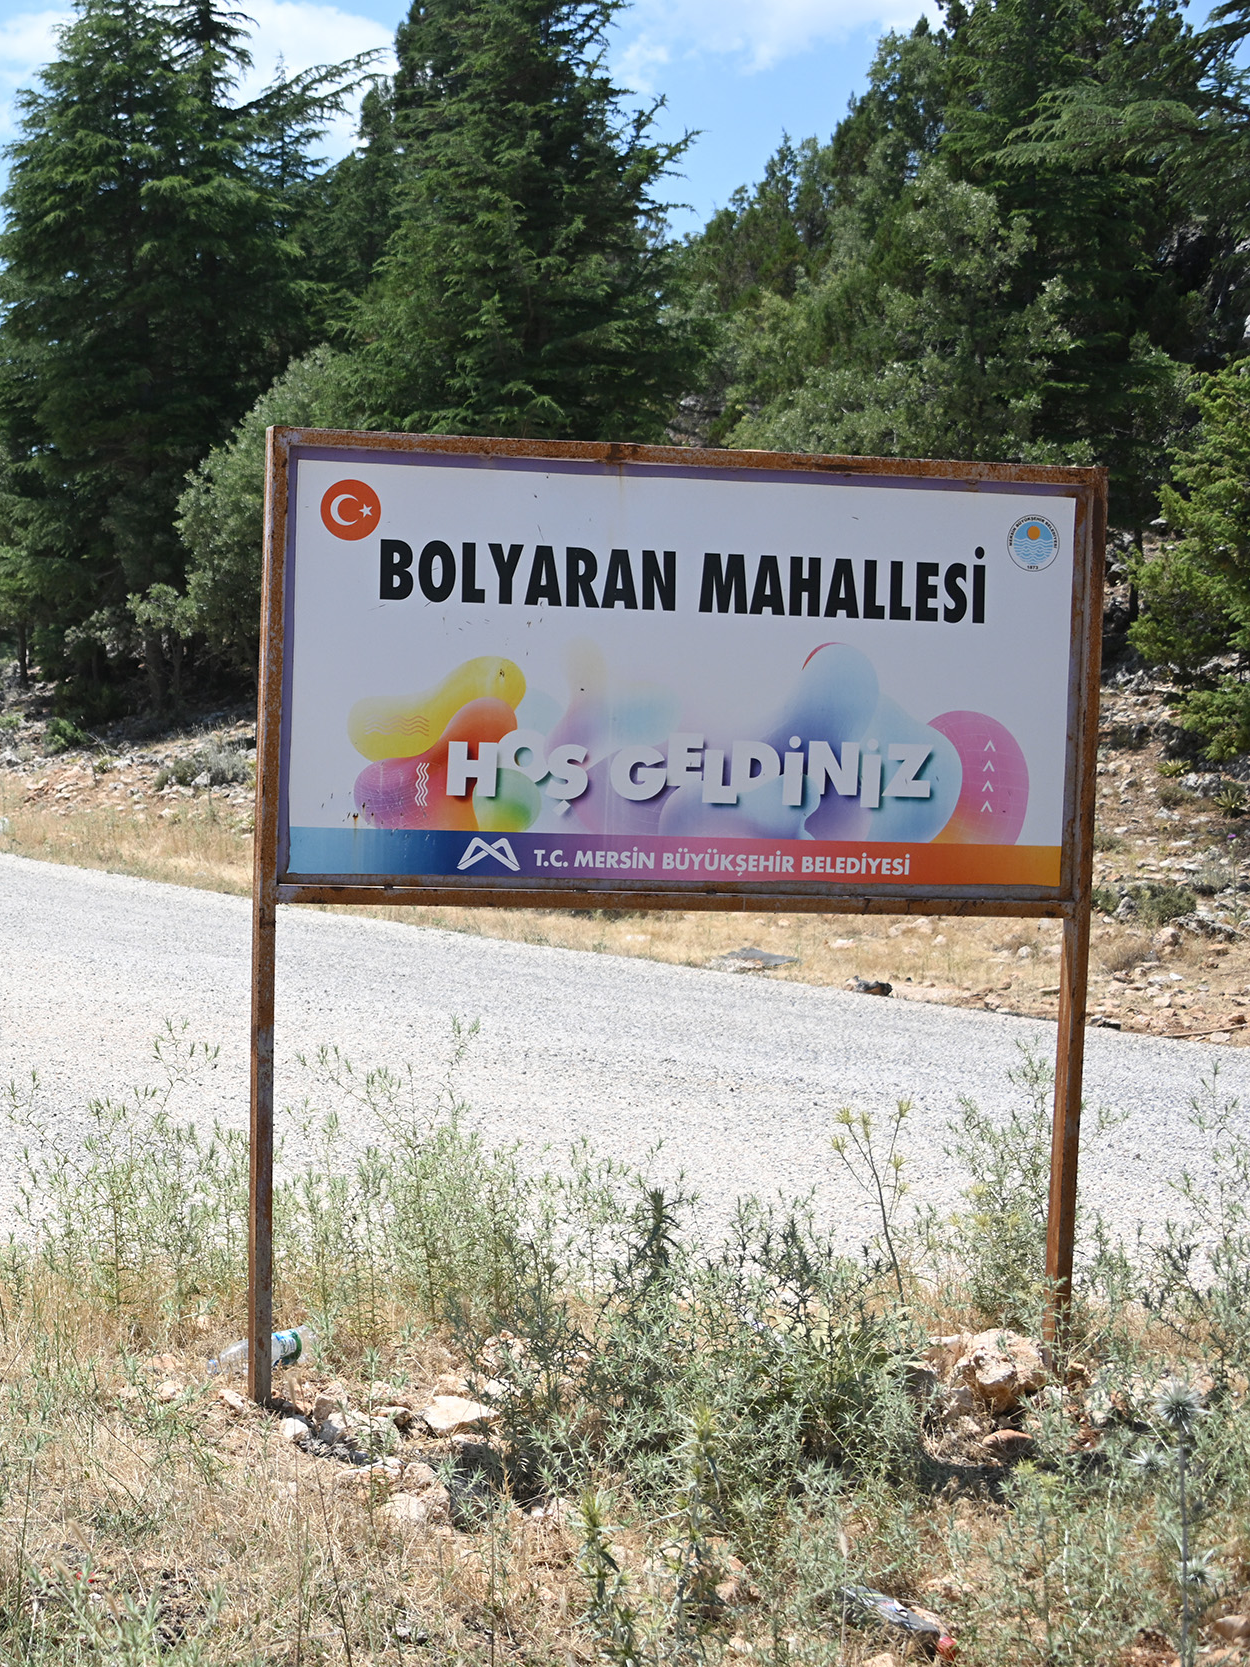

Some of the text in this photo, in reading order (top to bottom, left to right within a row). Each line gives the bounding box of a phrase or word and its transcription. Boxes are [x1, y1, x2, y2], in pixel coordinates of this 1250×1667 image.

[380, 538, 986, 624] BOLYARAN MAHALLESİ
[446, 729, 934, 816] HOŞ GELDİNİZ
[534, 847, 911, 877] T.C. MERSİN BÜYÜKŞEHİR BELEDİYESİ
